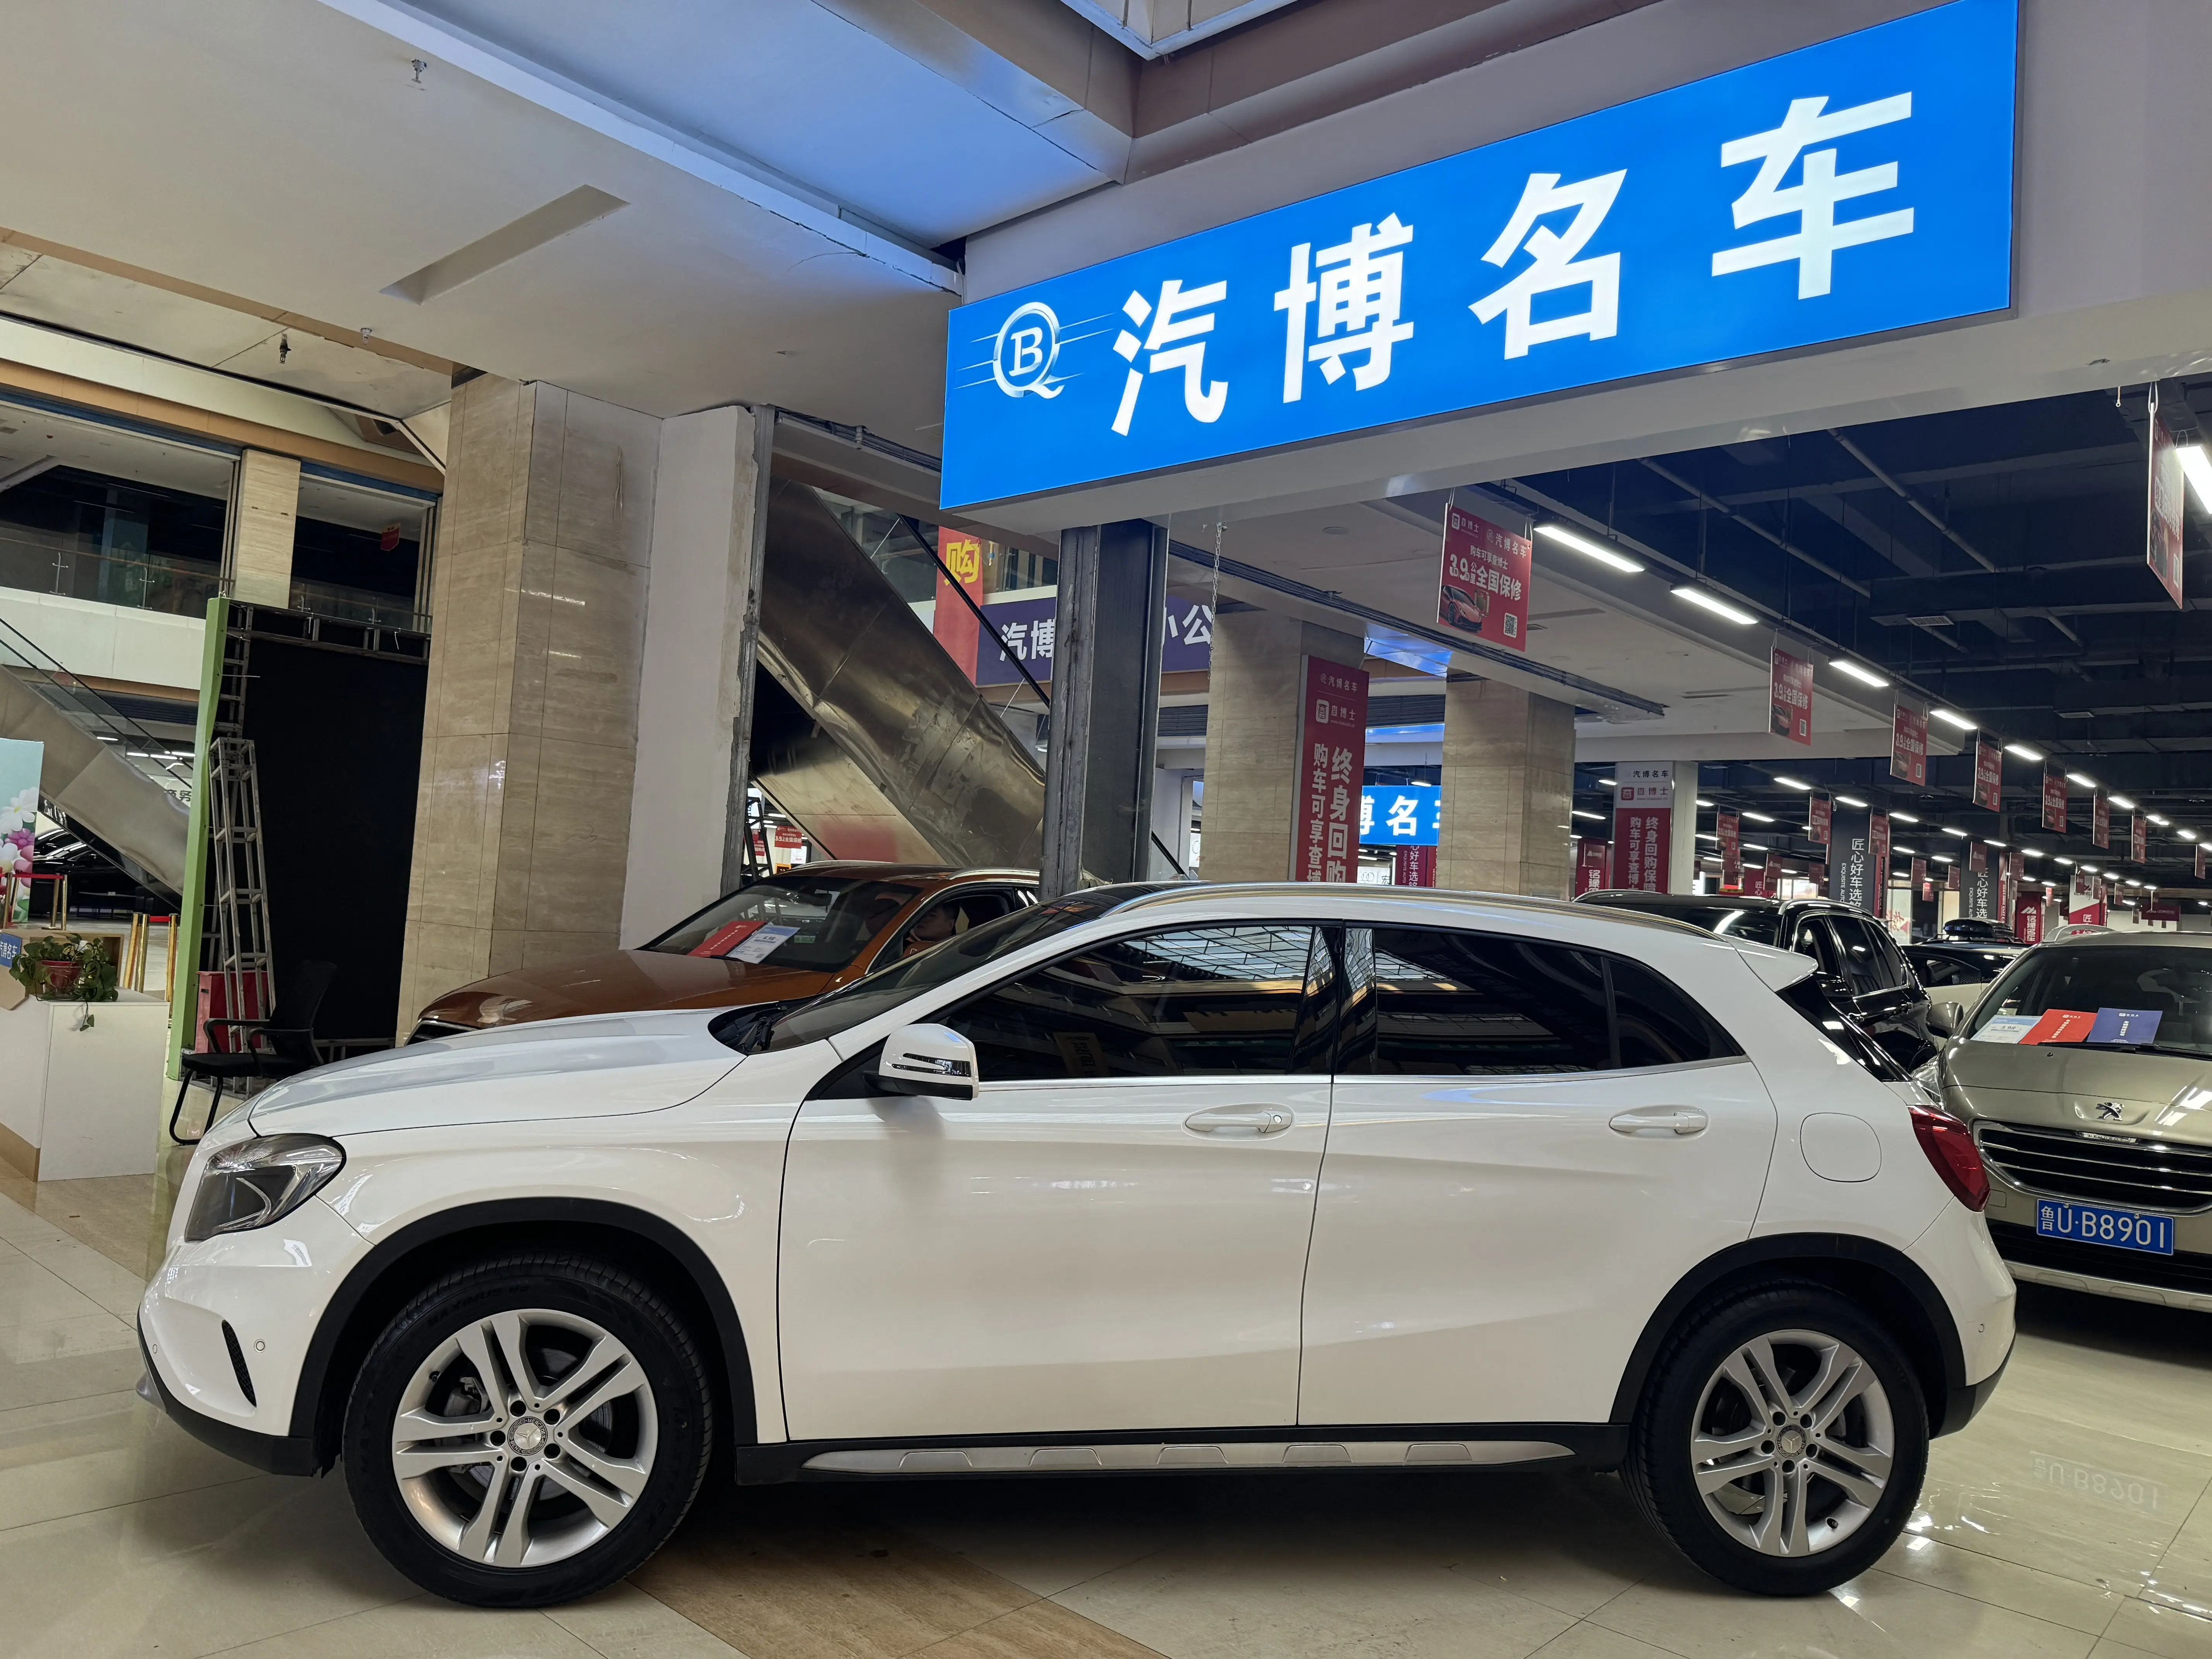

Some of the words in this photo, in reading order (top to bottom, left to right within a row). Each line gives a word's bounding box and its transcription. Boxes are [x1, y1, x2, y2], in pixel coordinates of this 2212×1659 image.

[1111, 91, 1915, 437] 汽博名车
[1495, 533, 1527, 558] 汽博名车
[944, 538, 980, 586] 购
[1470, 545, 1508, 570] 购车可享查博士
[1328, 675, 1358, 693] 汽博名车
[1331, 705, 1355, 721] 查博士
[1633, 770, 1669, 778] 汽博名车
[2040, 1205, 2165, 1249] 鲁U·B8901
[527, 1419, 546, 1439] MERCEDES
[510, 1440, 522, 1453] BENZ
